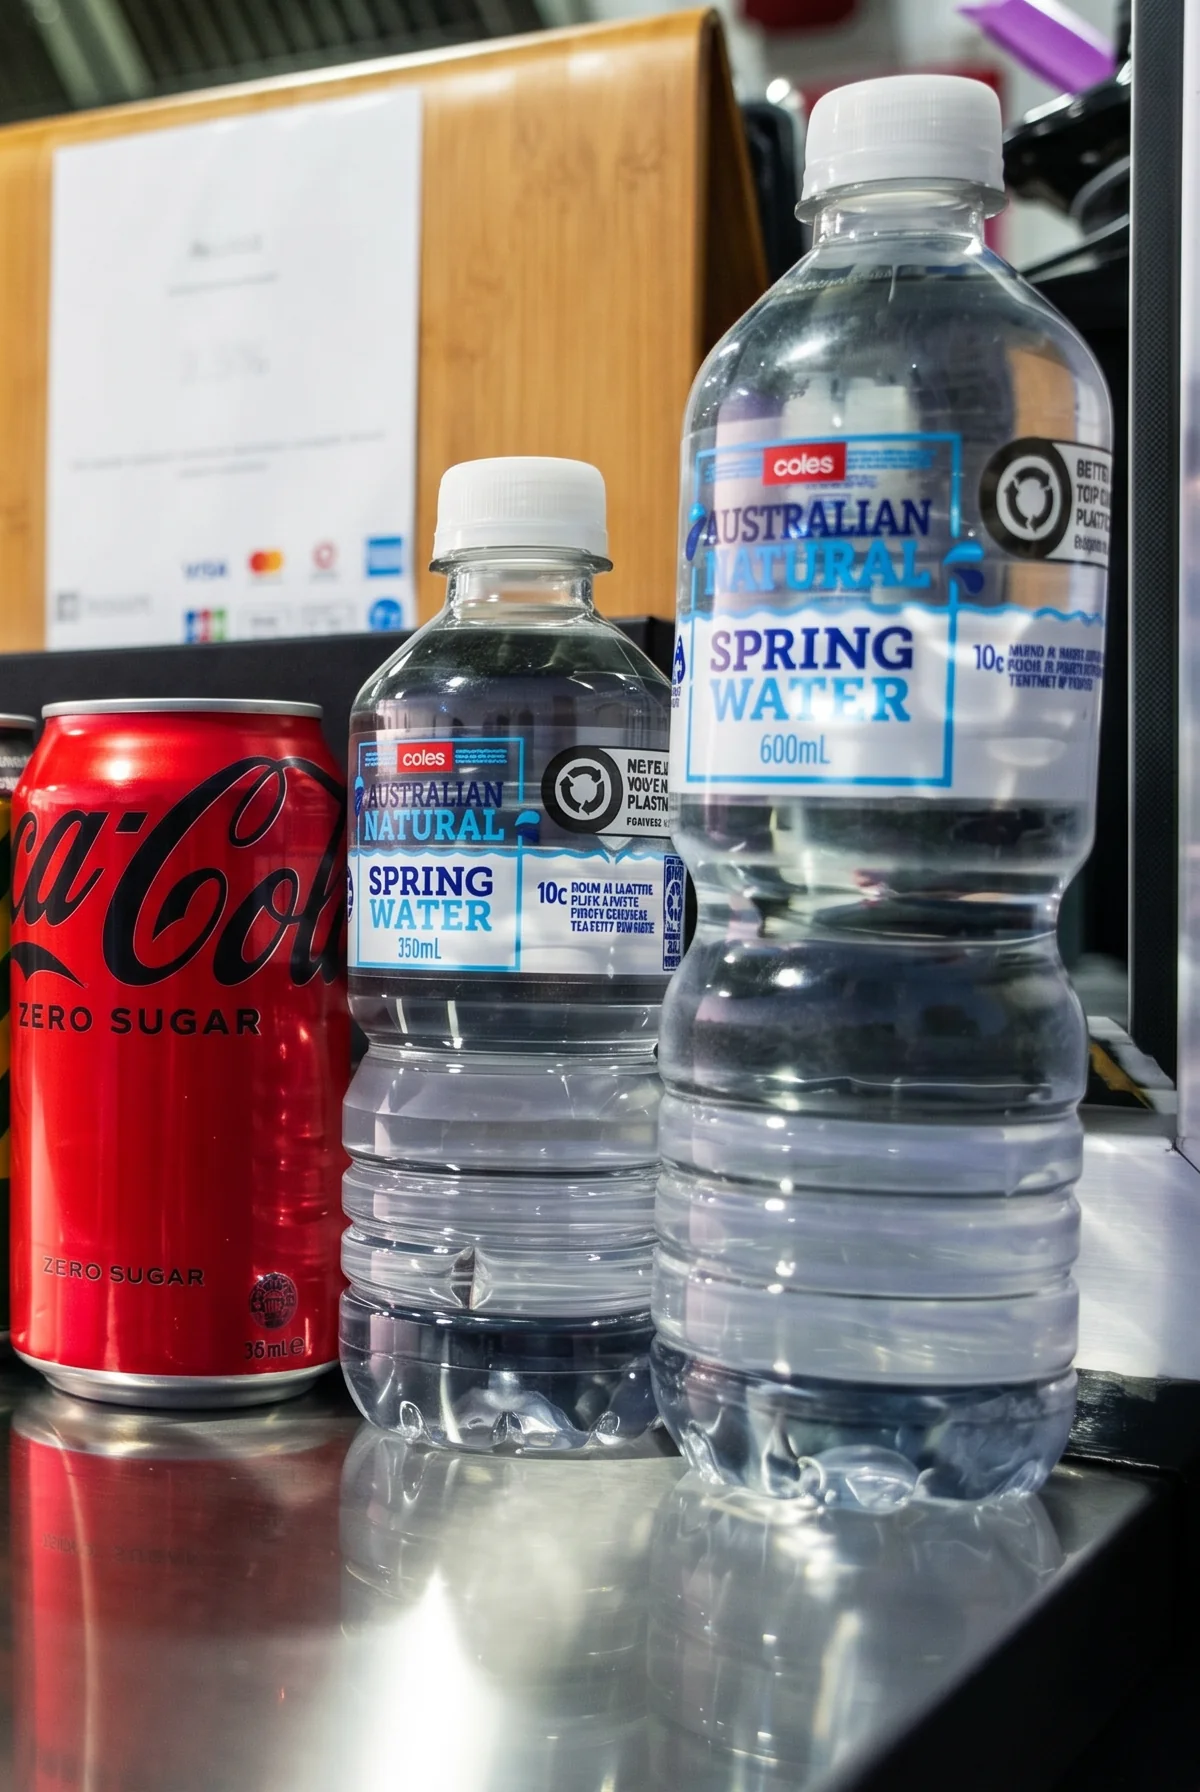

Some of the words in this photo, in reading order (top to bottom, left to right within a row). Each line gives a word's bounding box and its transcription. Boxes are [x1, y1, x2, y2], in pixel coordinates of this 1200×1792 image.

[773, 453, 834, 477] coles
[703, 499, 933, 547] AUSTRALIAN
[704, 540, 932, 597] NATURAL
[710, 627, 914, 673] SPRING
[710, 677, 912, 723] WATER
[402, 749, 446, 768] coles
[759, 734, 831, 765] 600mL
[367, 781, 505, 809] AUSTRALIAN
[363, 809, 505, 842] NATURAL
[369, 865, 494, 897] SPRING
[537, 881, 568, 905] 10c
[369, 898, 493, 932] WATER
[397, 937, 442, 960] 350mL
[18, 1002, 93, 1033] ZERO
[110, 1007, 262, 1037] SUGAR
[43, 1256, 102, 1281] ZERO
[109, 1264, 206, 1287] SUGAR
